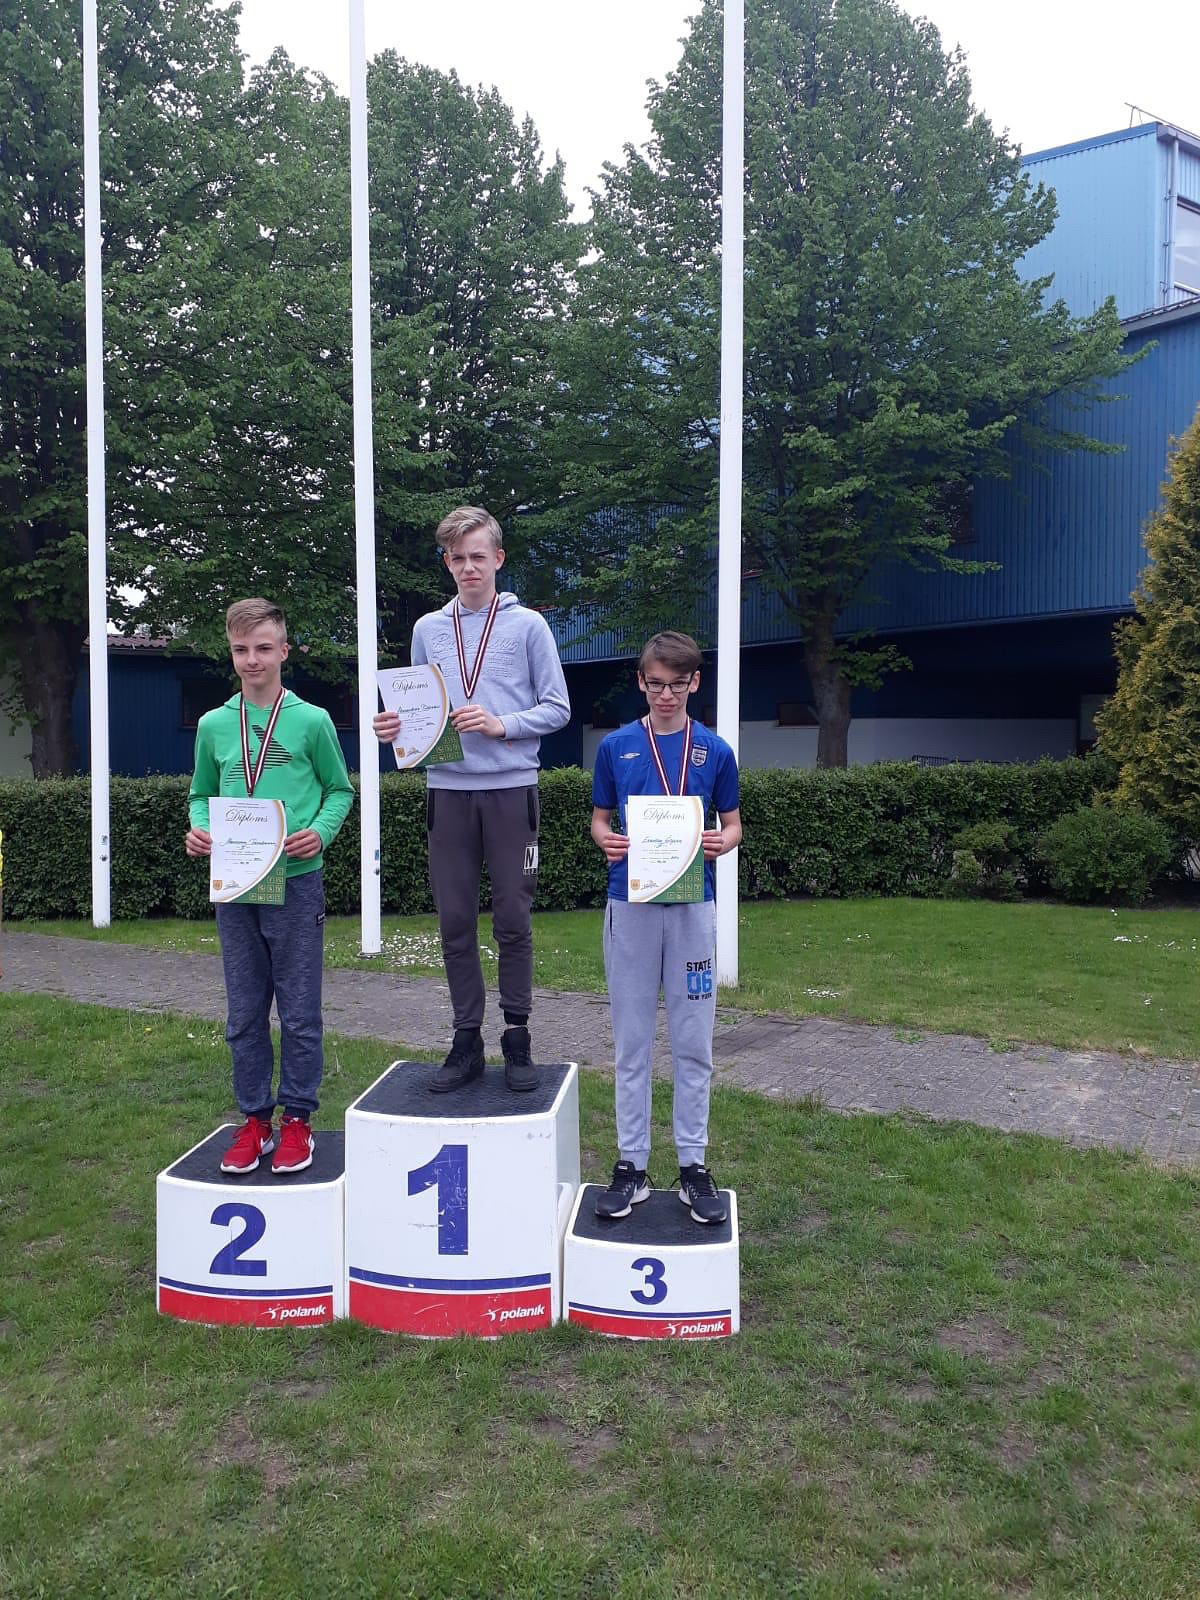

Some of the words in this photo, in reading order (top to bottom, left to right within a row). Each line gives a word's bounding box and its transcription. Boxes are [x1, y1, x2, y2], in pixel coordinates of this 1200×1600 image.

[225, 808, 268, 826] Diploms
[641, 807, 686, 824] Diploms
[686, 958, 712, 972] STATE
[687, 969, 713, 994] 06
[407, 1144, 469, 1256] 1
[209, 1202, 267, 1277] 2
[630, 1257, 668, 1306] 3
[280, 1304, 327, 1321] polanik
[500, 1304, 546, 1322] polanik
[680, 1320, 726, 1336] polanik
